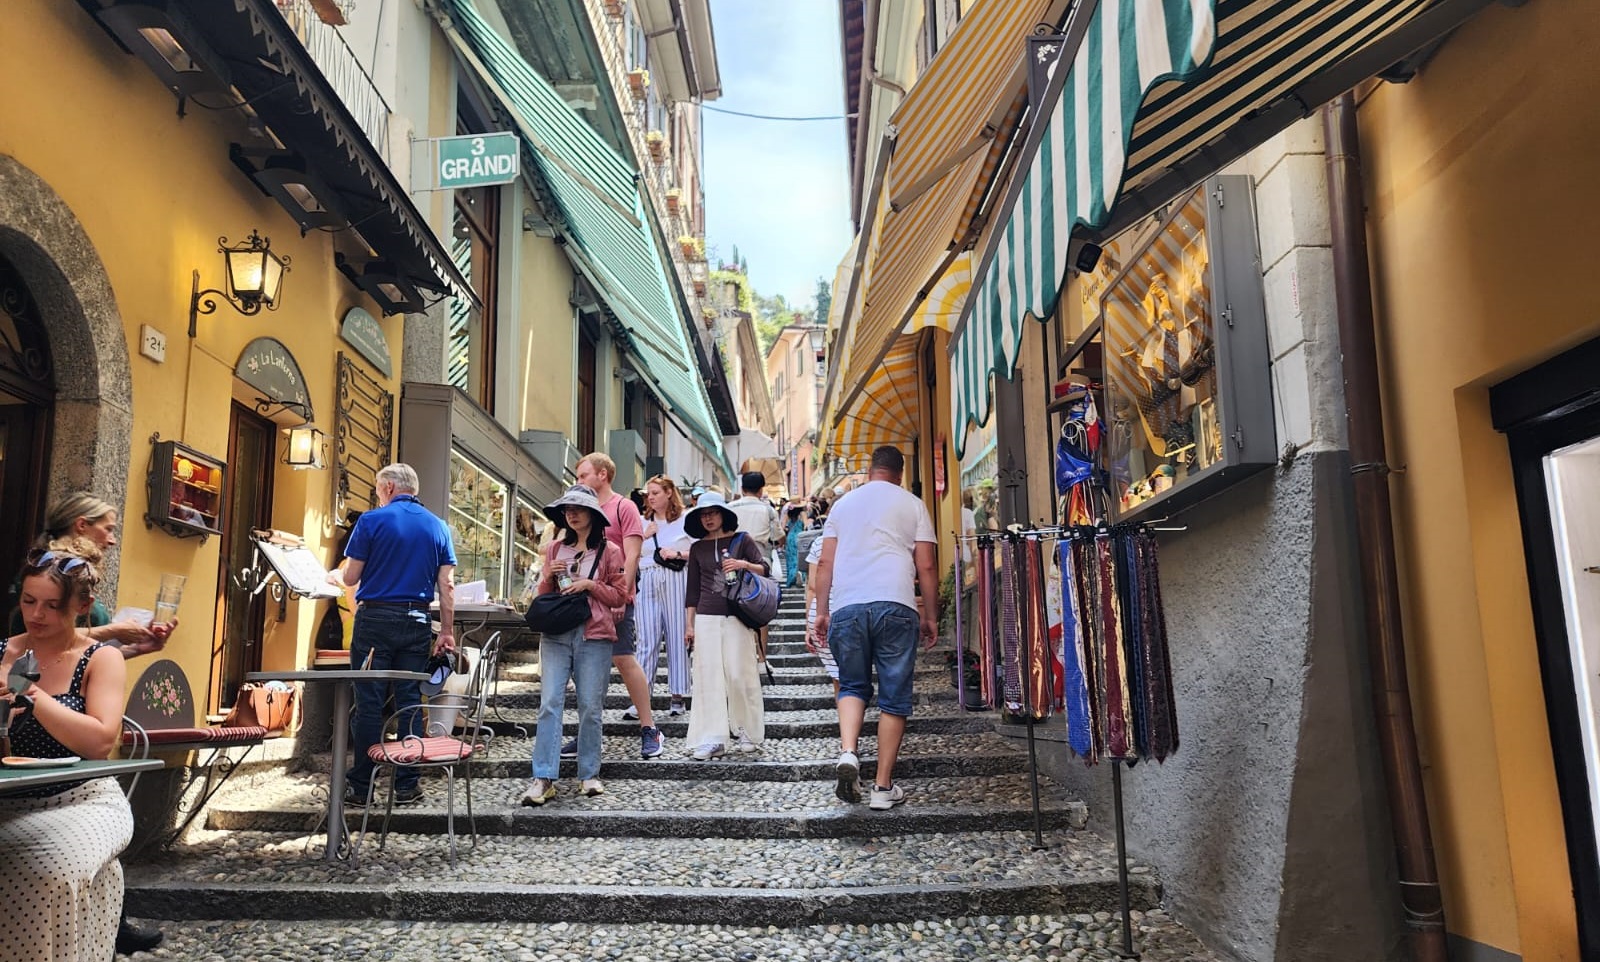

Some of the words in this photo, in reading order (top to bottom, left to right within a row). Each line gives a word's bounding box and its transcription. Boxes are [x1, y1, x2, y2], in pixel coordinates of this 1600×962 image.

[471, 137, 485, 156] 3
[441, 154, 516, 180] GRANDI
[260, 351, 270, 366] La
